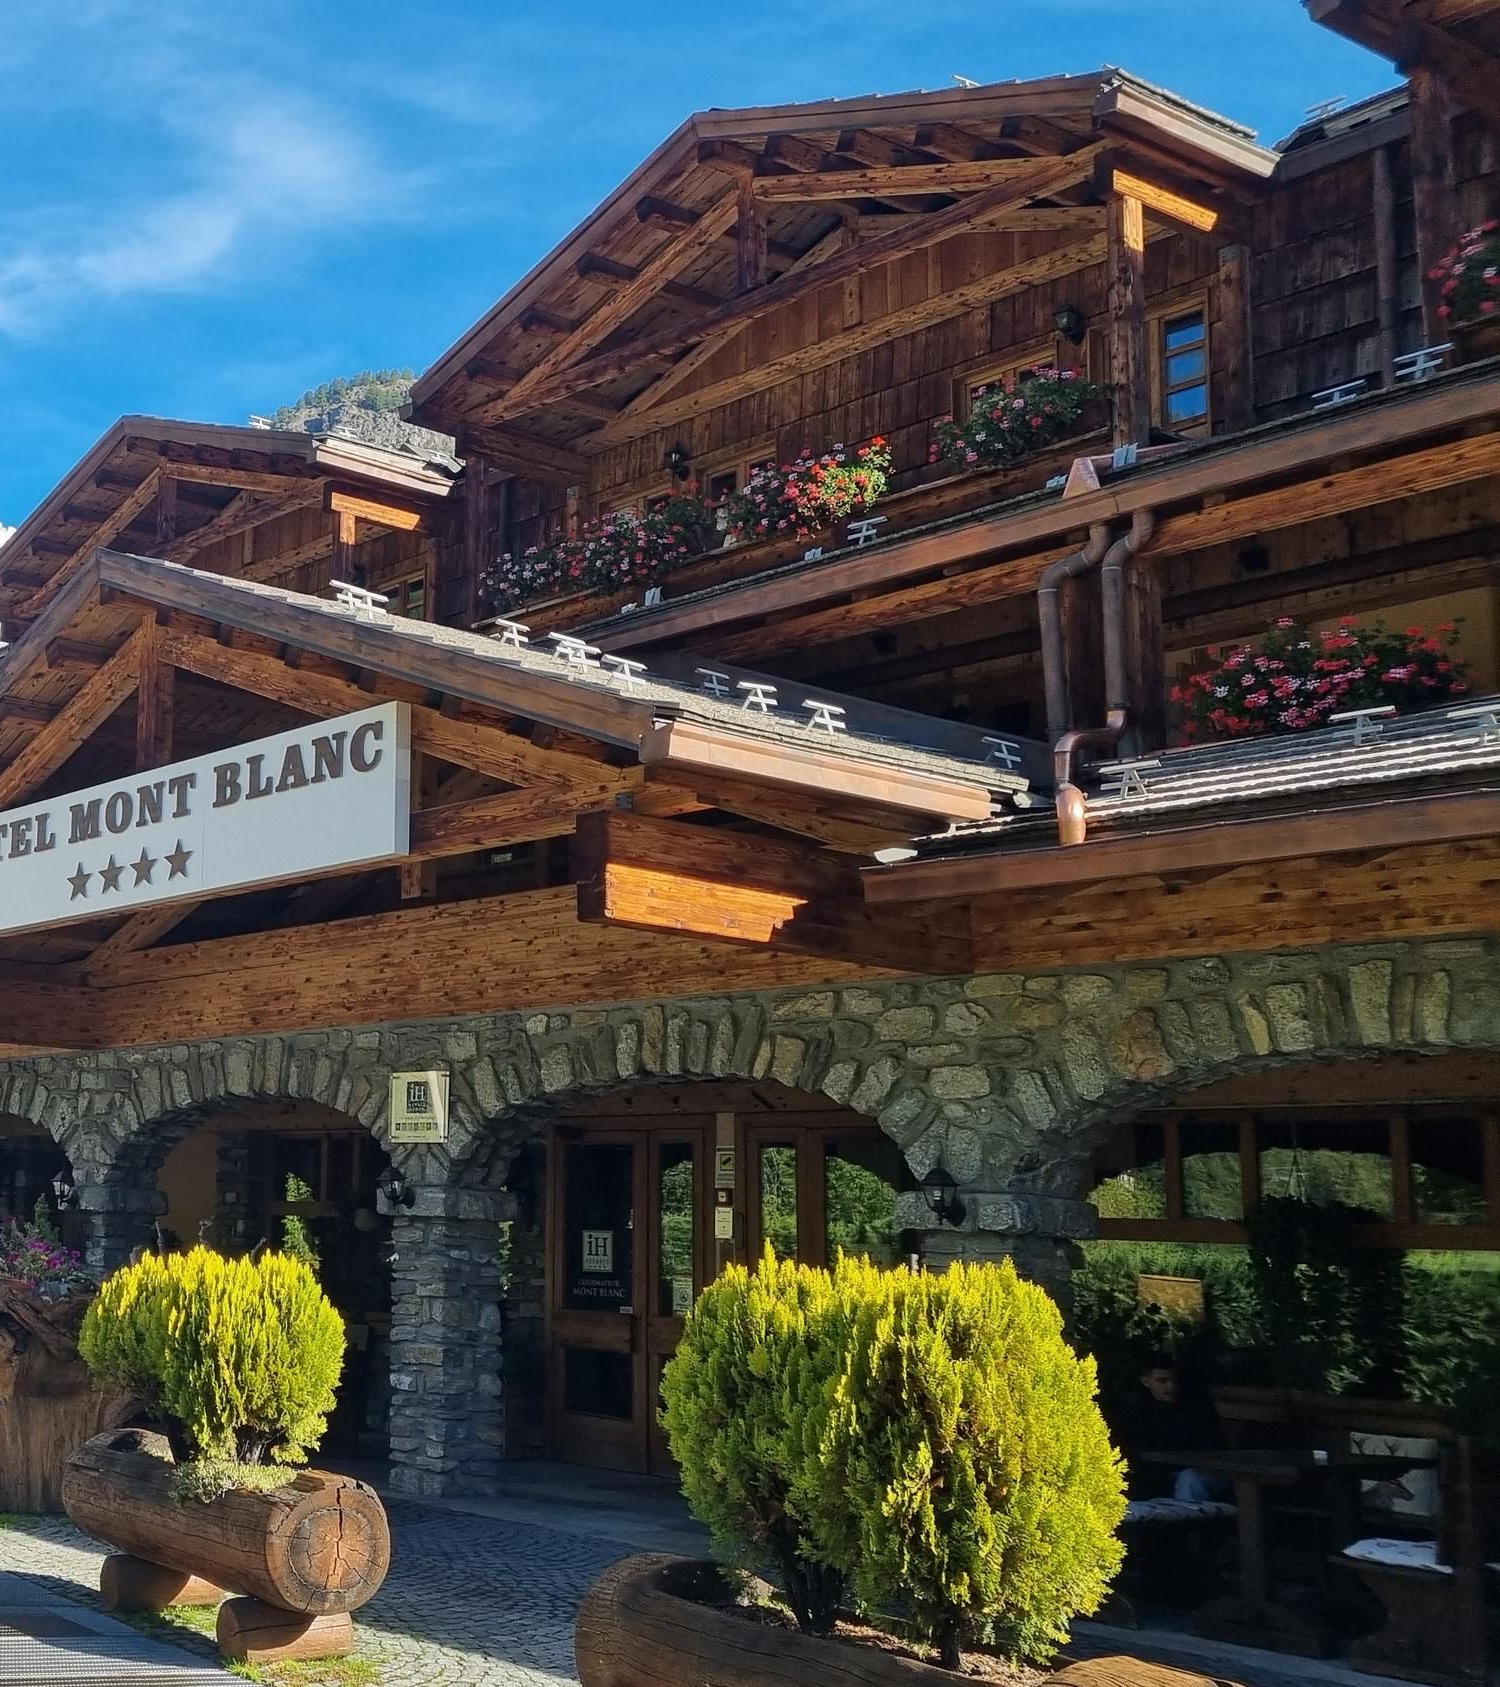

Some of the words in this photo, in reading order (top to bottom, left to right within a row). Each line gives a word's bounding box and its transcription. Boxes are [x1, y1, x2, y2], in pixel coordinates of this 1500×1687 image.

[68, 772, 197, 844] MONT
[212, 720, 384, 808] BLANC
[586, 1233, 609, 1257] iH
[572, 1287, 597, 1297] MONT
[599, 1288, 627, 1298] BLANC
